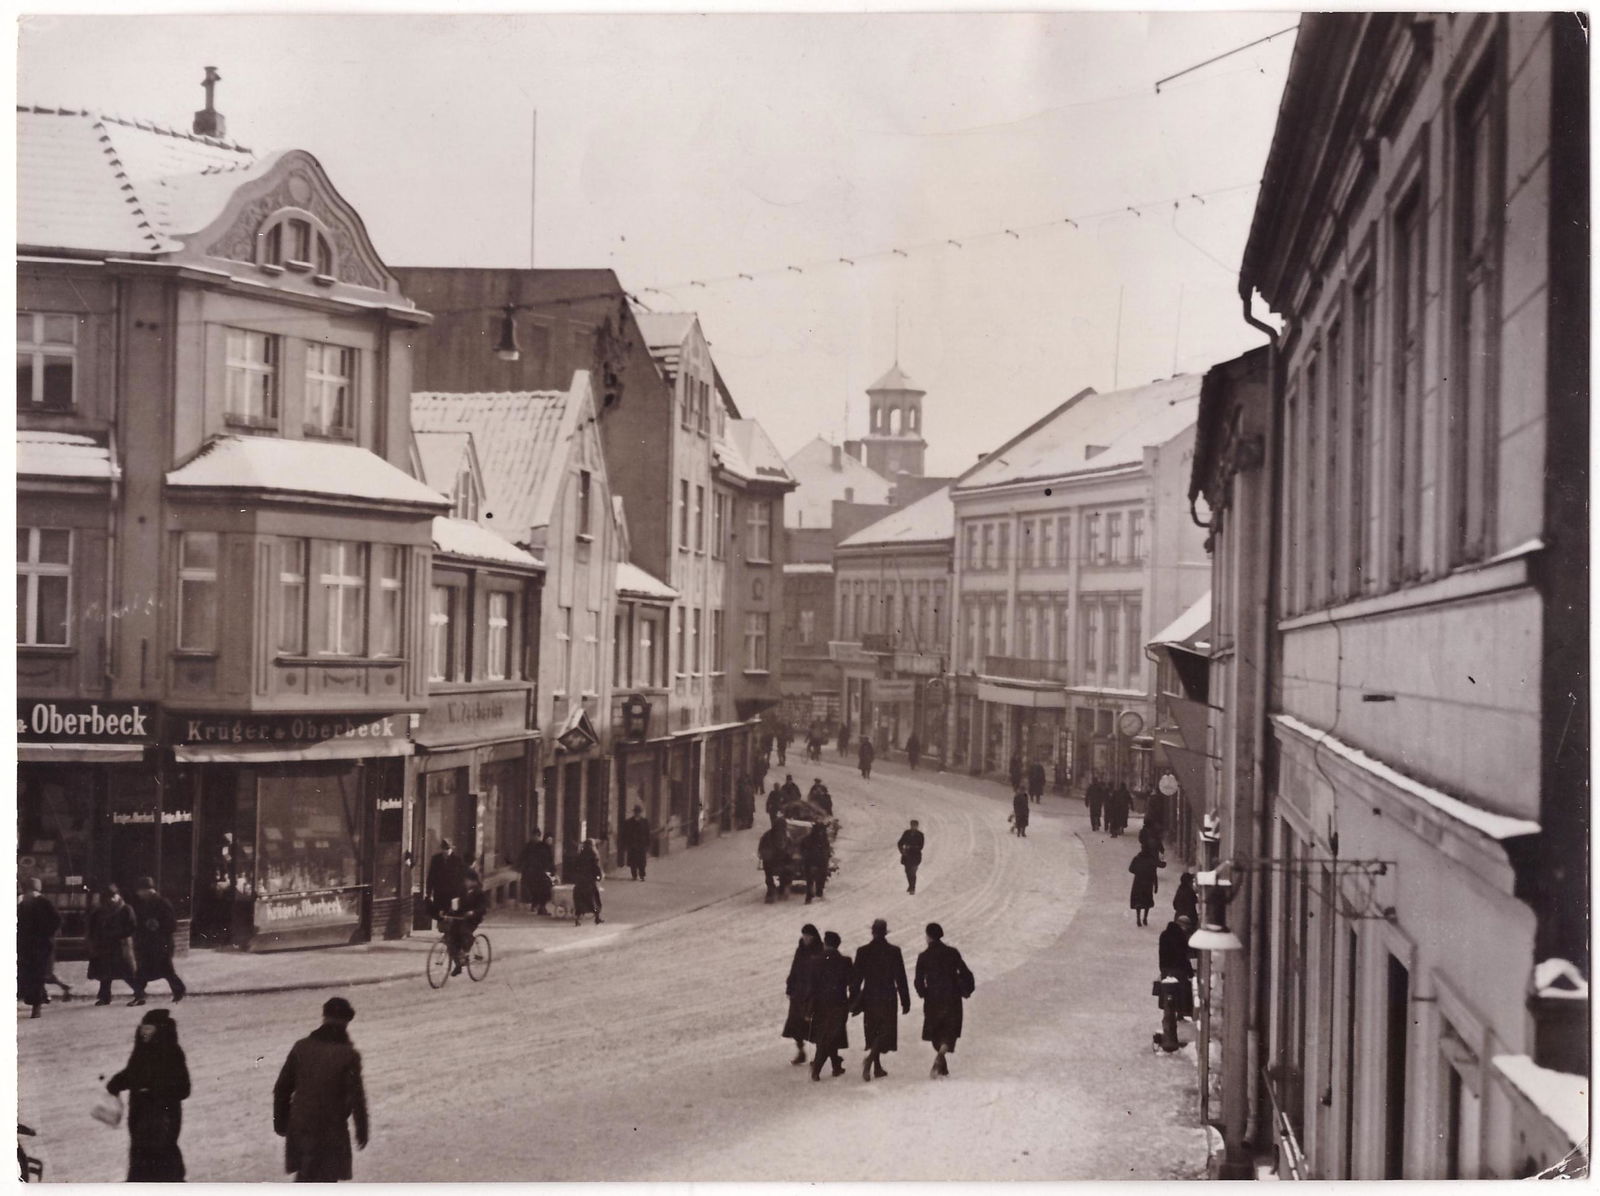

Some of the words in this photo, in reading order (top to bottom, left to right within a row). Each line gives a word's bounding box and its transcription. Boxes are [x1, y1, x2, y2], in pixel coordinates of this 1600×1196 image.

[31, 703, 147, 735] Oberbeck
[187, 719, 270, 742] Krüger
[291, 717, 395, 739] Oberbeck
